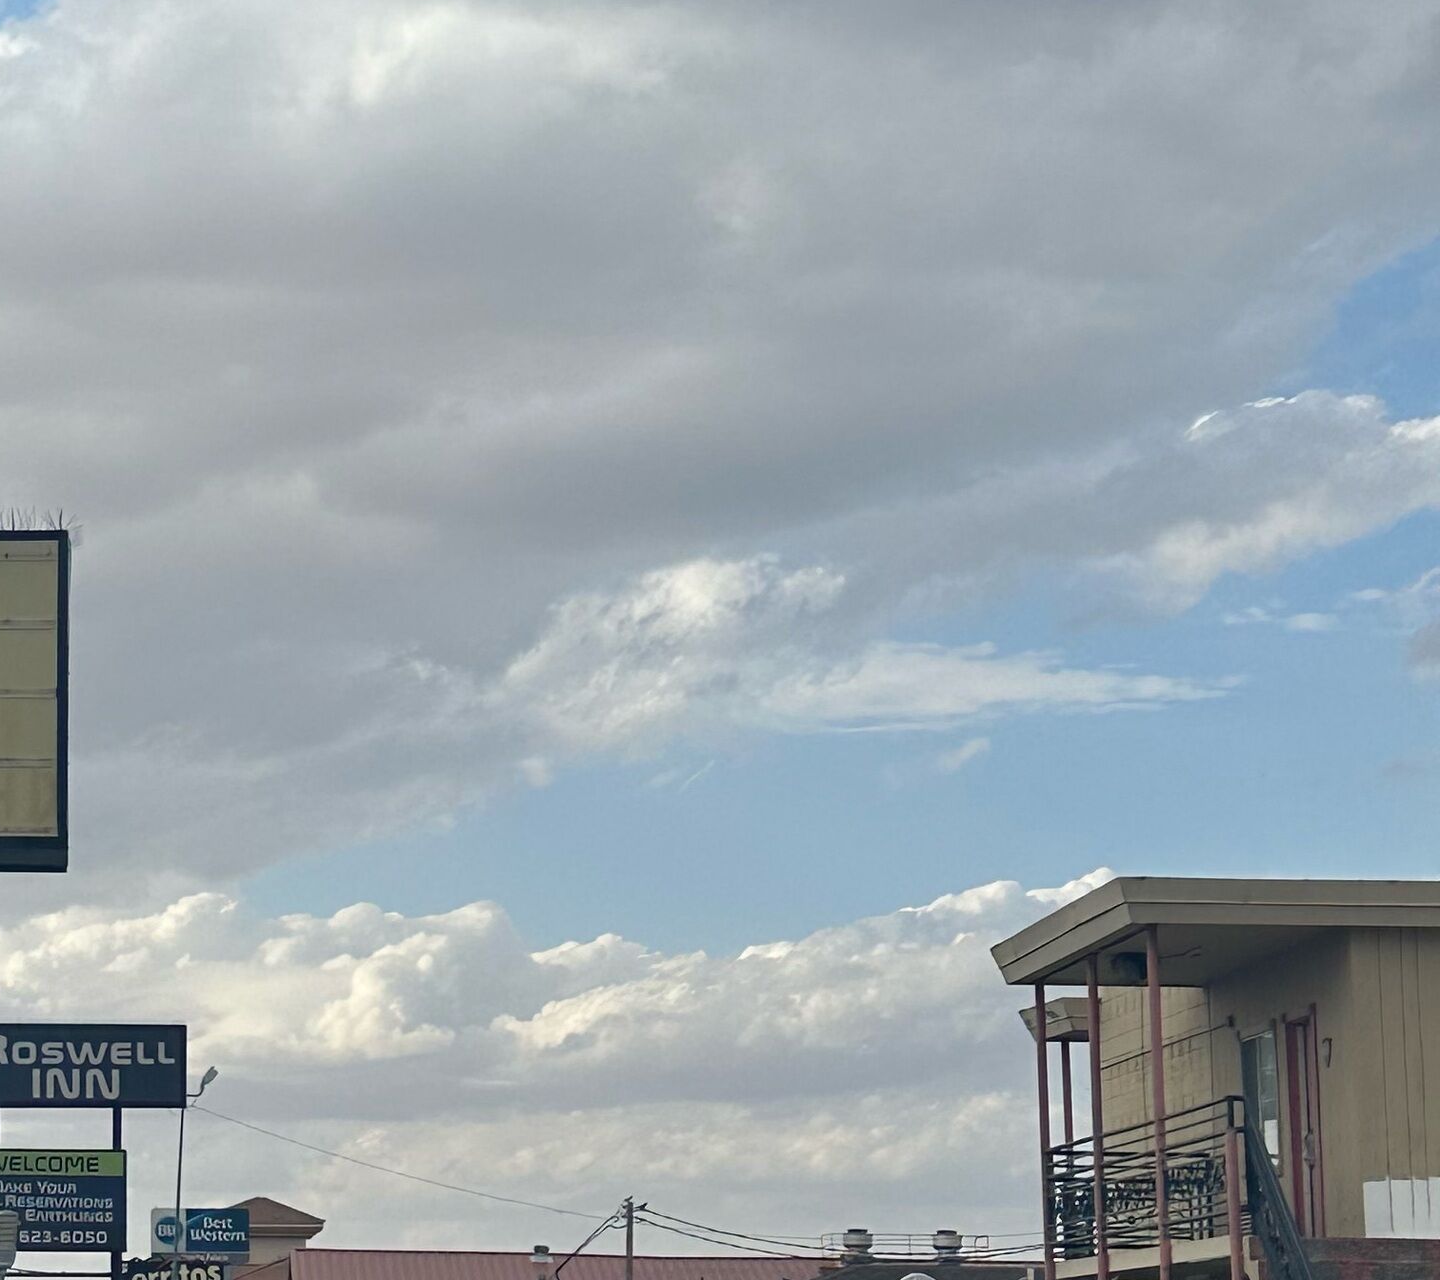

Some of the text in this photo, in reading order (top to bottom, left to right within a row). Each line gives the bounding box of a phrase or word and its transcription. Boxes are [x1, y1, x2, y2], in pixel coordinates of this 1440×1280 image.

[31, 1067, 120, 1099] INN
[37, 1180, 77, 1195] YOUR
[5, 1195, 113, 1208] RESERVATIONS
[203, 1216, 233, 1229] Best
[190, 1228, 247, 1242] Western
